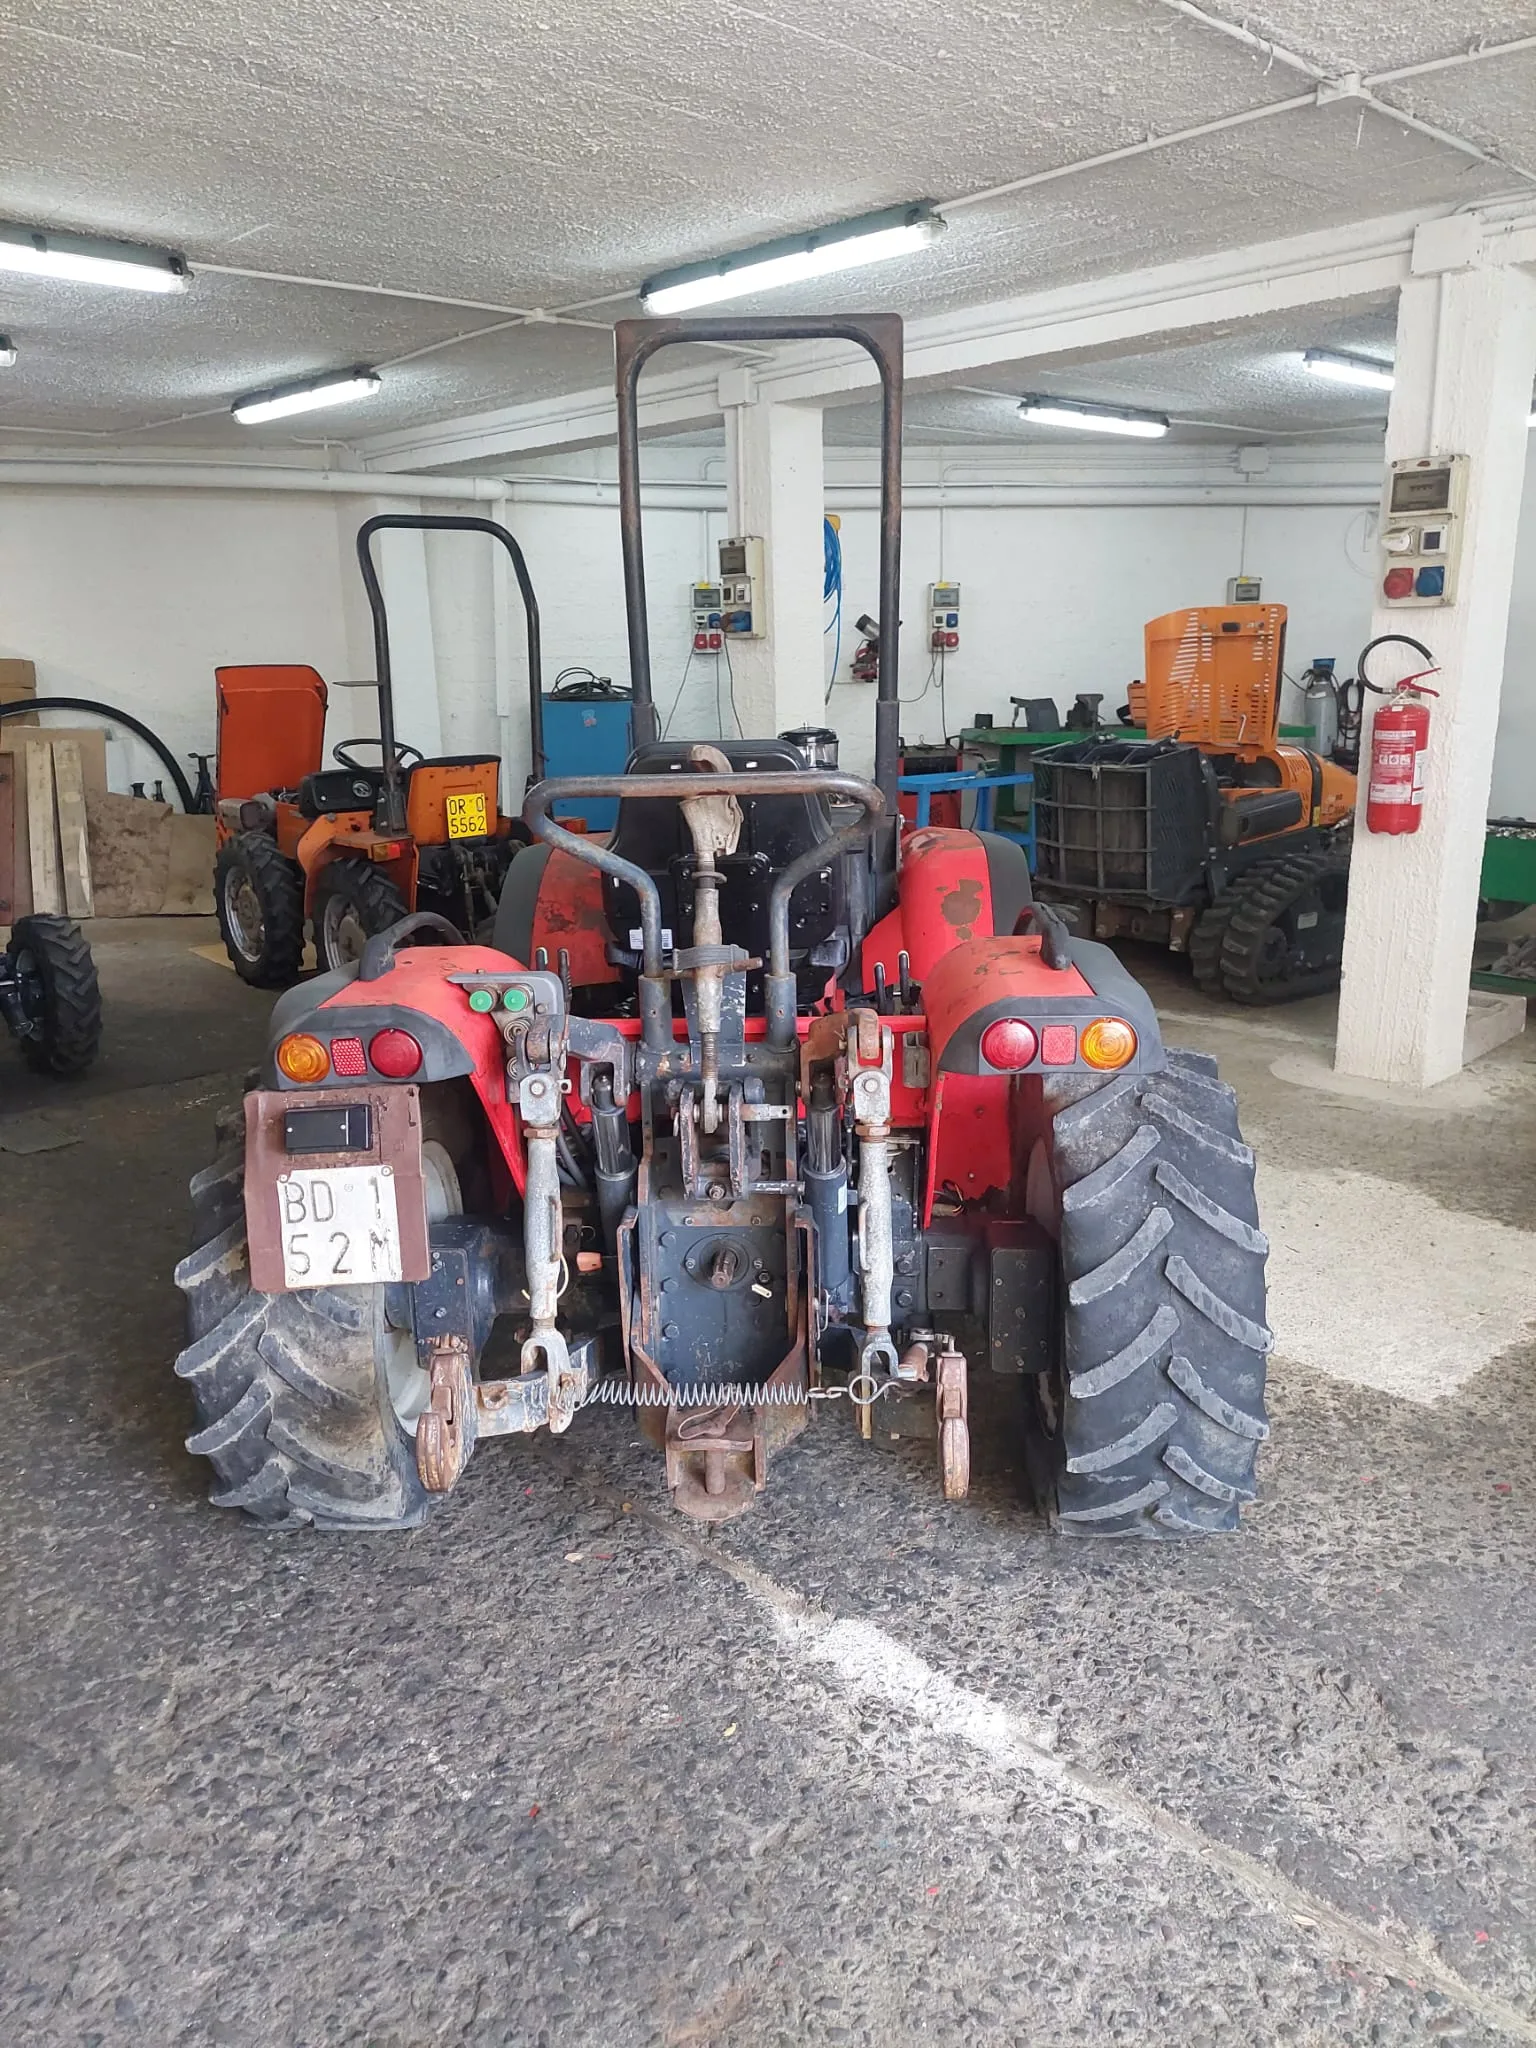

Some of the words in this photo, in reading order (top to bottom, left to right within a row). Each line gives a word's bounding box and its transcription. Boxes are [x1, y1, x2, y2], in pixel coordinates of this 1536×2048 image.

[449, 798, 466, 815] OR
[450, 815, 486, 834] 5562
[285, 1180, 334, 1224] BD
